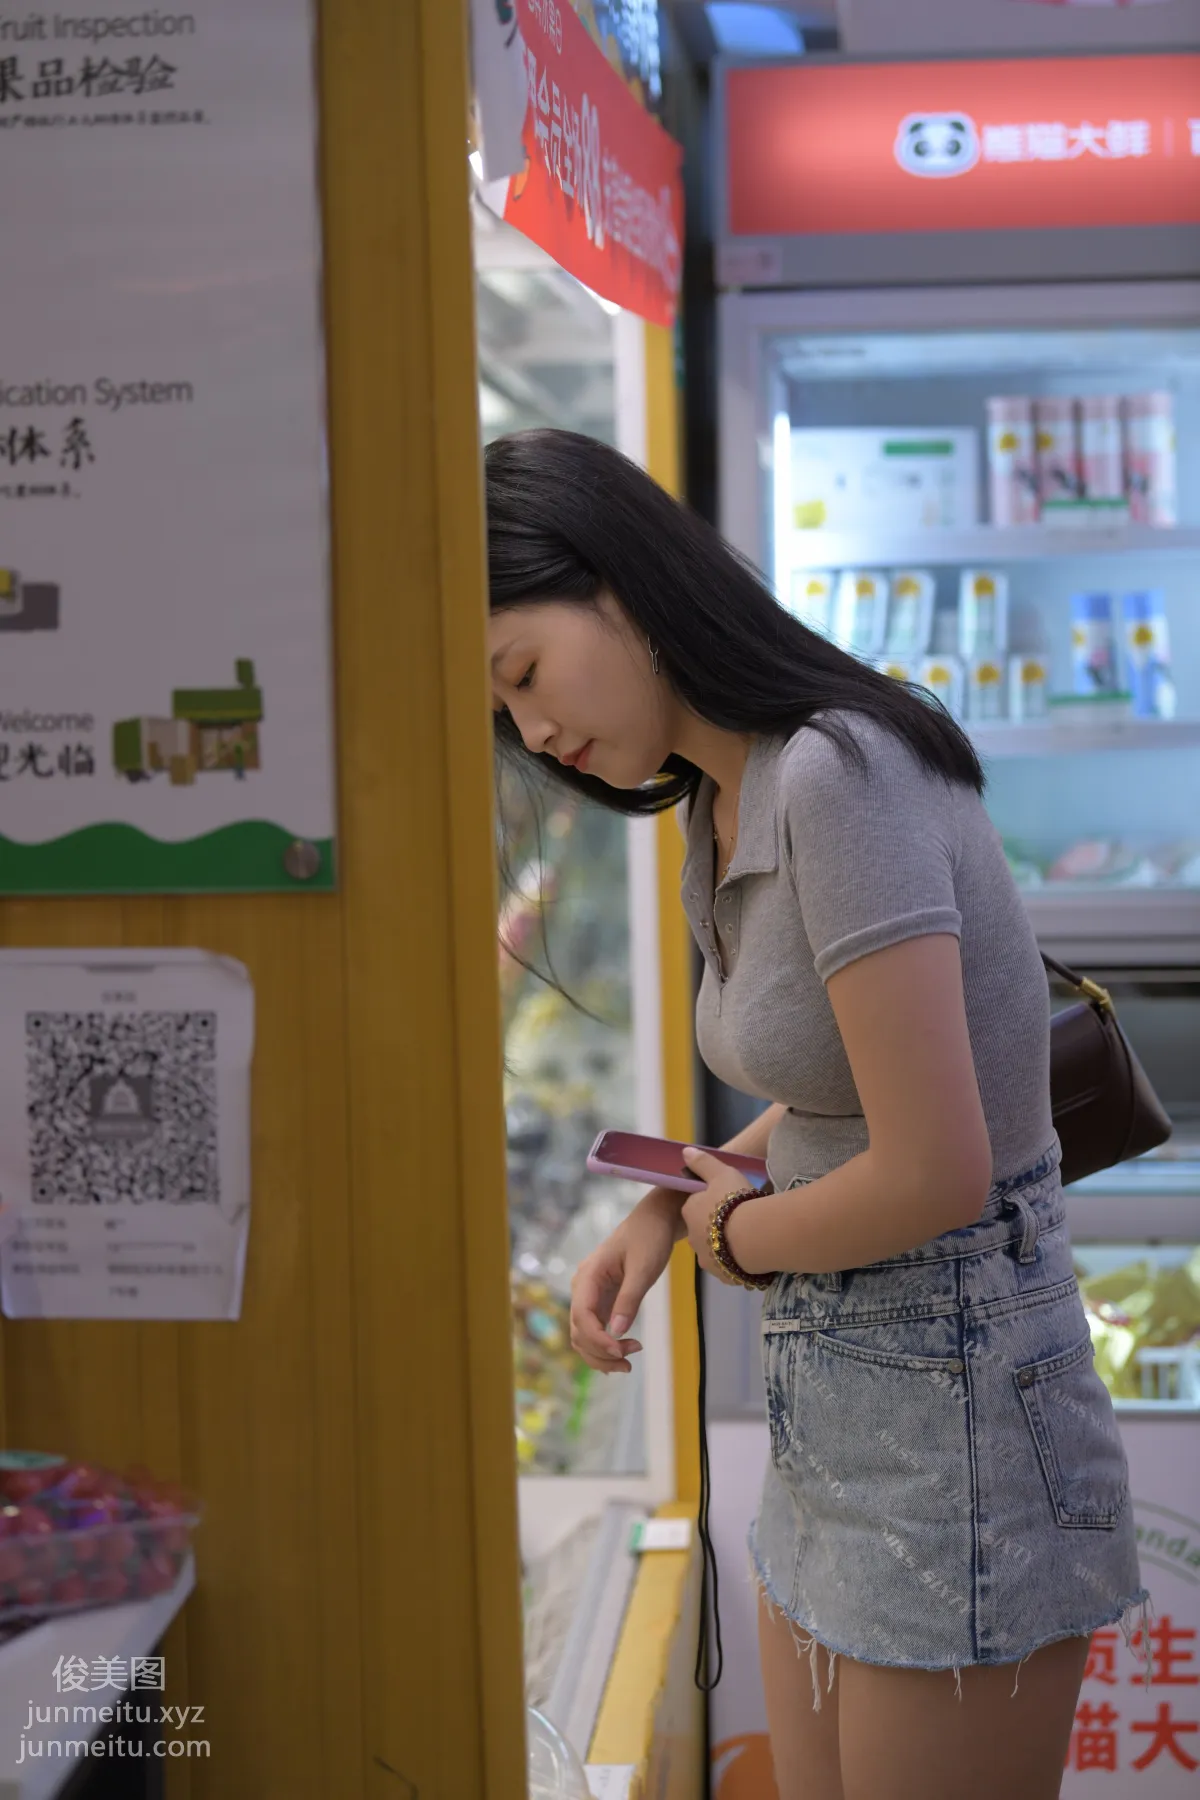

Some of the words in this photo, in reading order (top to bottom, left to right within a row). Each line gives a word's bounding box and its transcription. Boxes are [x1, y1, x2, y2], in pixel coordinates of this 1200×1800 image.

[0, 12, 47, 41] ruit
[54, 10, 196, 44] Inspection
[95, 376, 194, 411] System
[0, 417, 95, 471] 体系
